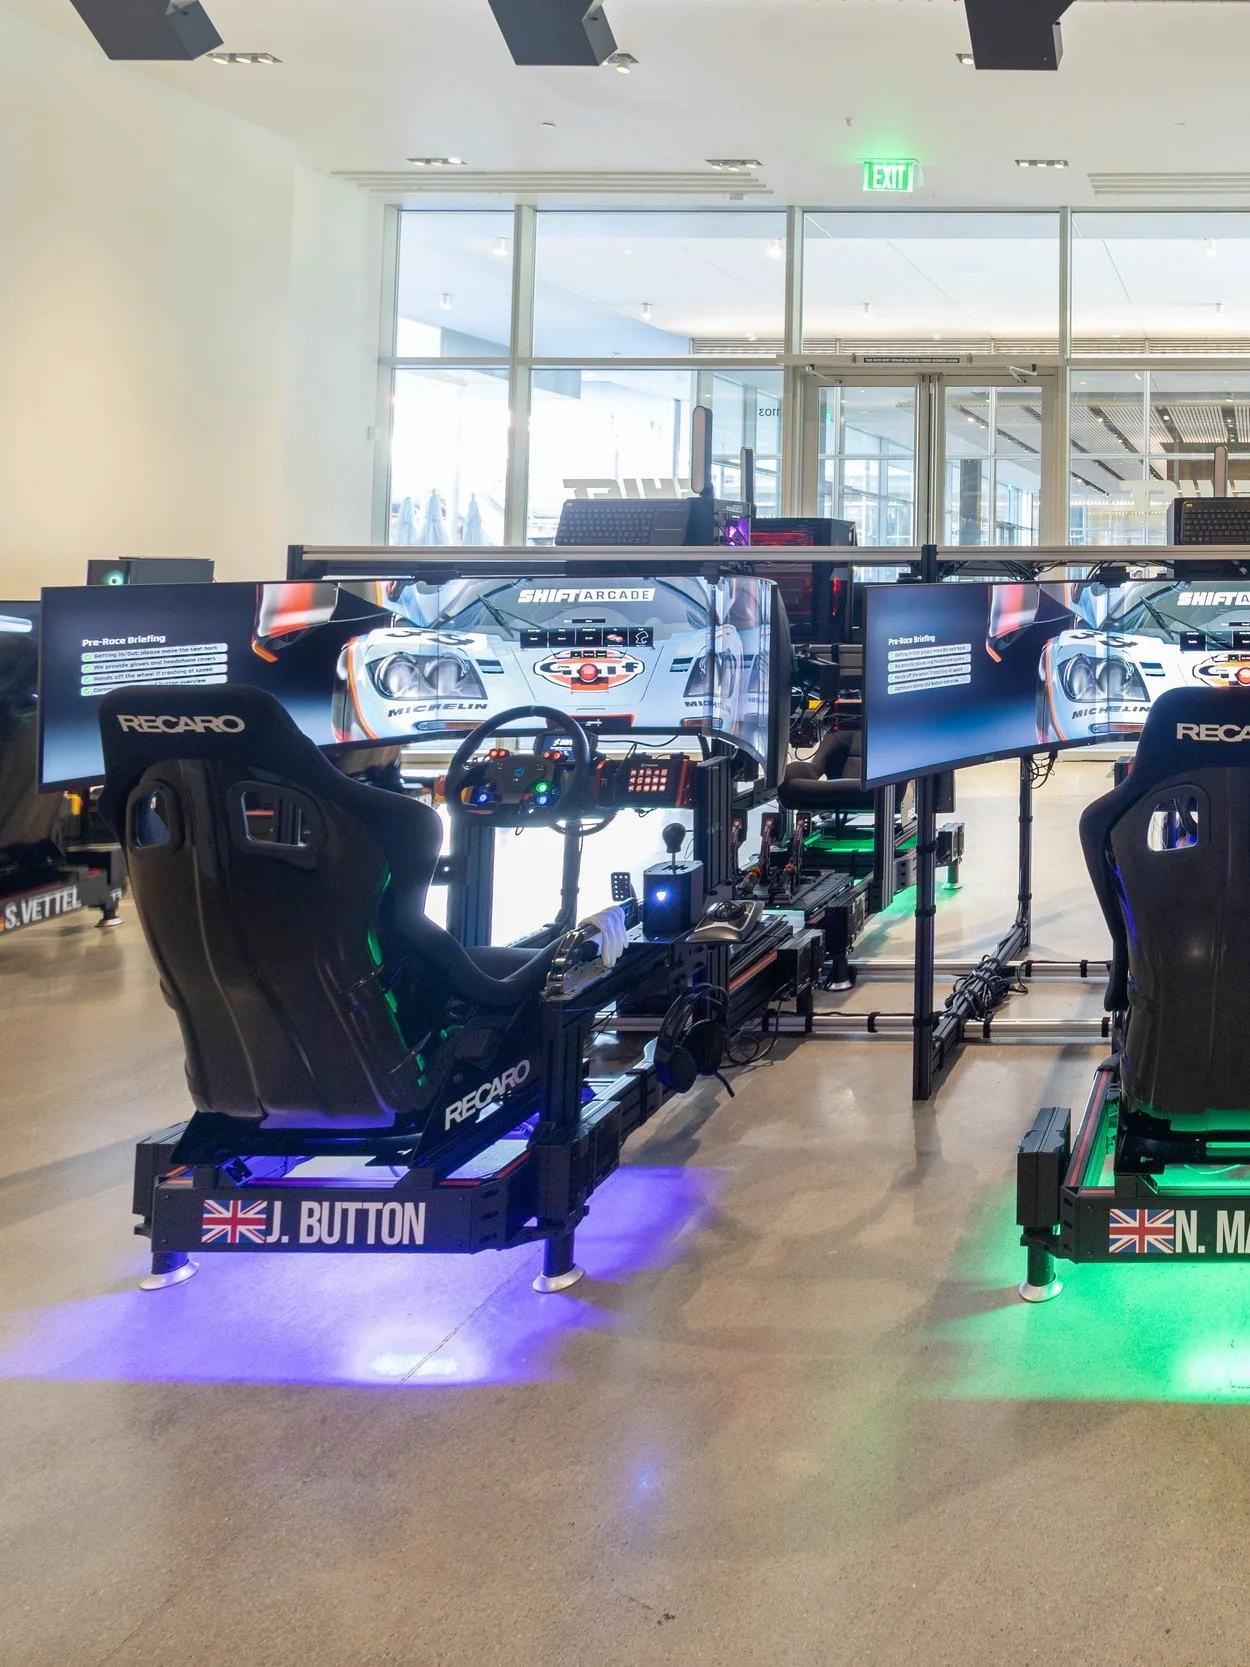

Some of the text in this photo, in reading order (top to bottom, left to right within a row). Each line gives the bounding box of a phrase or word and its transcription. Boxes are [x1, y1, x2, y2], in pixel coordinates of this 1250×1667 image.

[873, 164, 905, 189] EXIT
[82, 635, 166, 646] Pre-Race Briefing
[888, 635, 935, 646] Pre-Race Briefing
[388, 704, 488, 717] MICHELIN
[117, 715, 245, 733] RECARO
[21, 884, 82, 924] VETTEL
[445, 1060, 530, 1131] RECARO
[266, 1201, 426, 1244] J. BUTTON
[1176, 1210, 1205, 1253] N.
